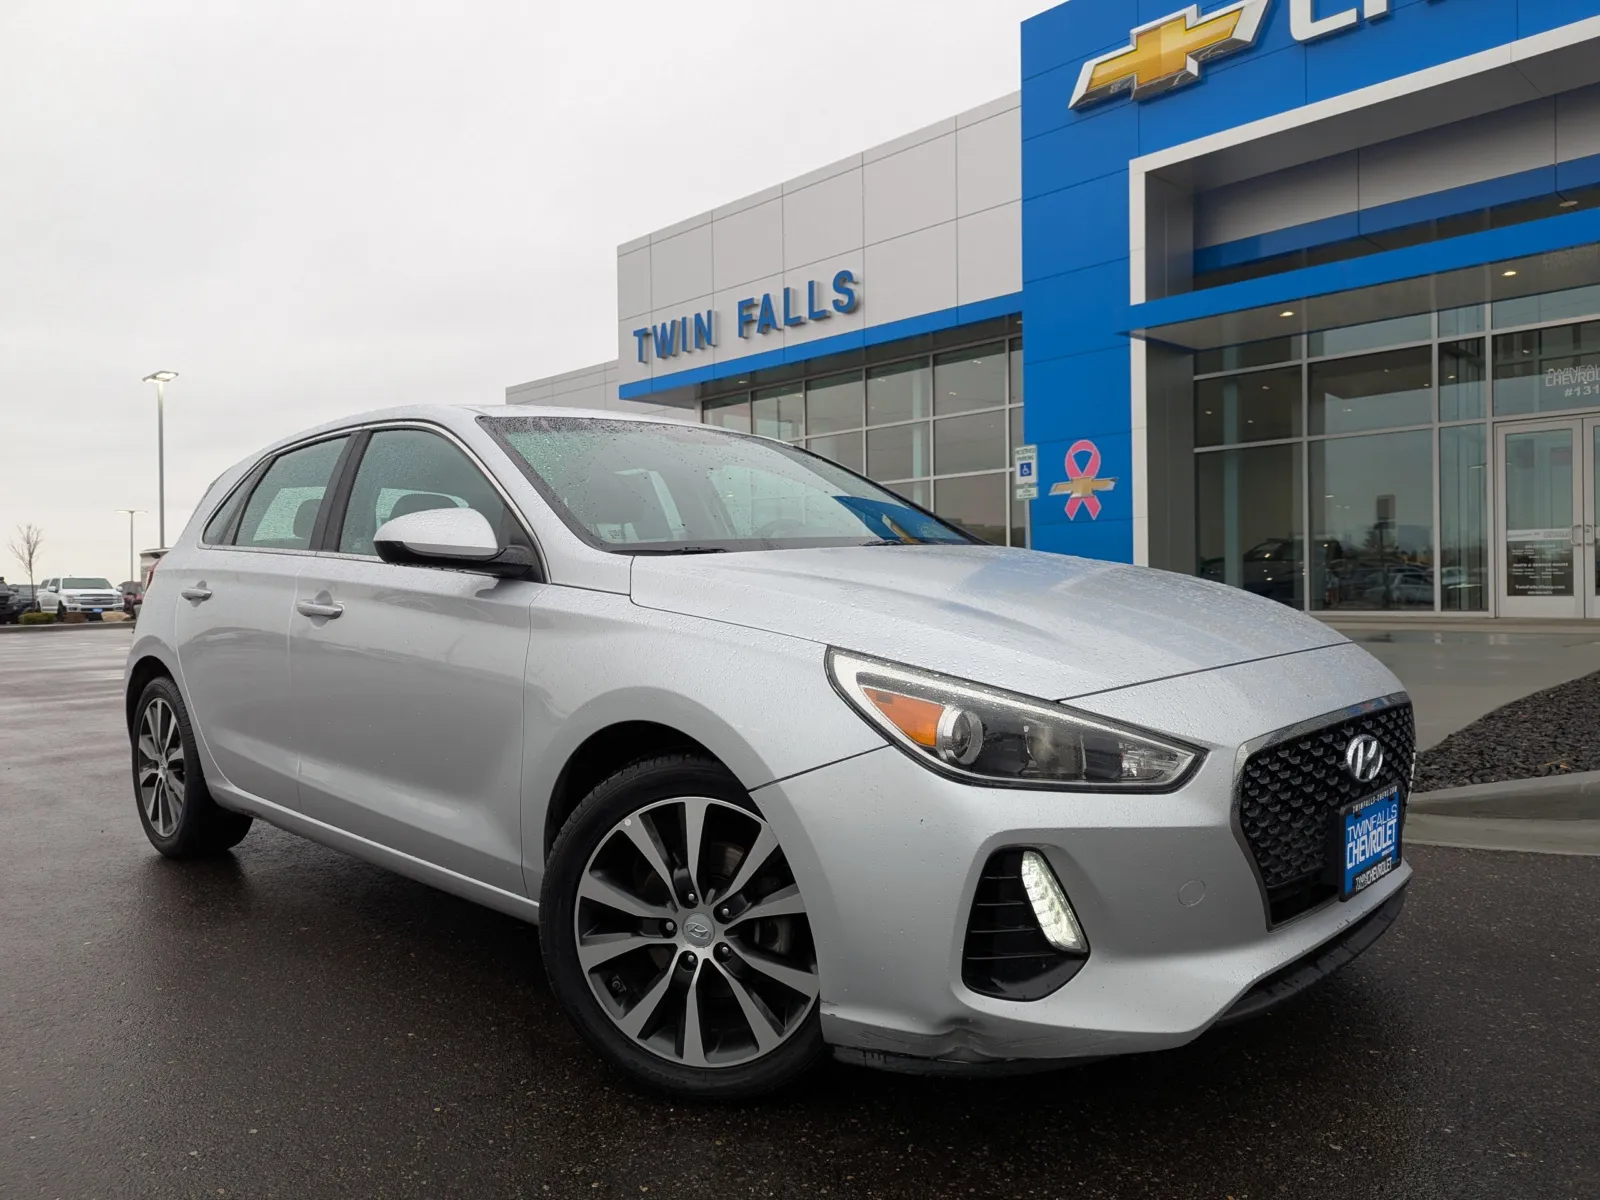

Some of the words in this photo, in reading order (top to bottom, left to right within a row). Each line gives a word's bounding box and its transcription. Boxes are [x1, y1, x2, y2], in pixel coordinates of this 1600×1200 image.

[633, 310, 716, 363] TWIN
[738, 270, 857, 339] FALLS
[1346, 818, 1398, 870] CHEVROLET
[1365, 857, 1393, 883] CHEVROLET
